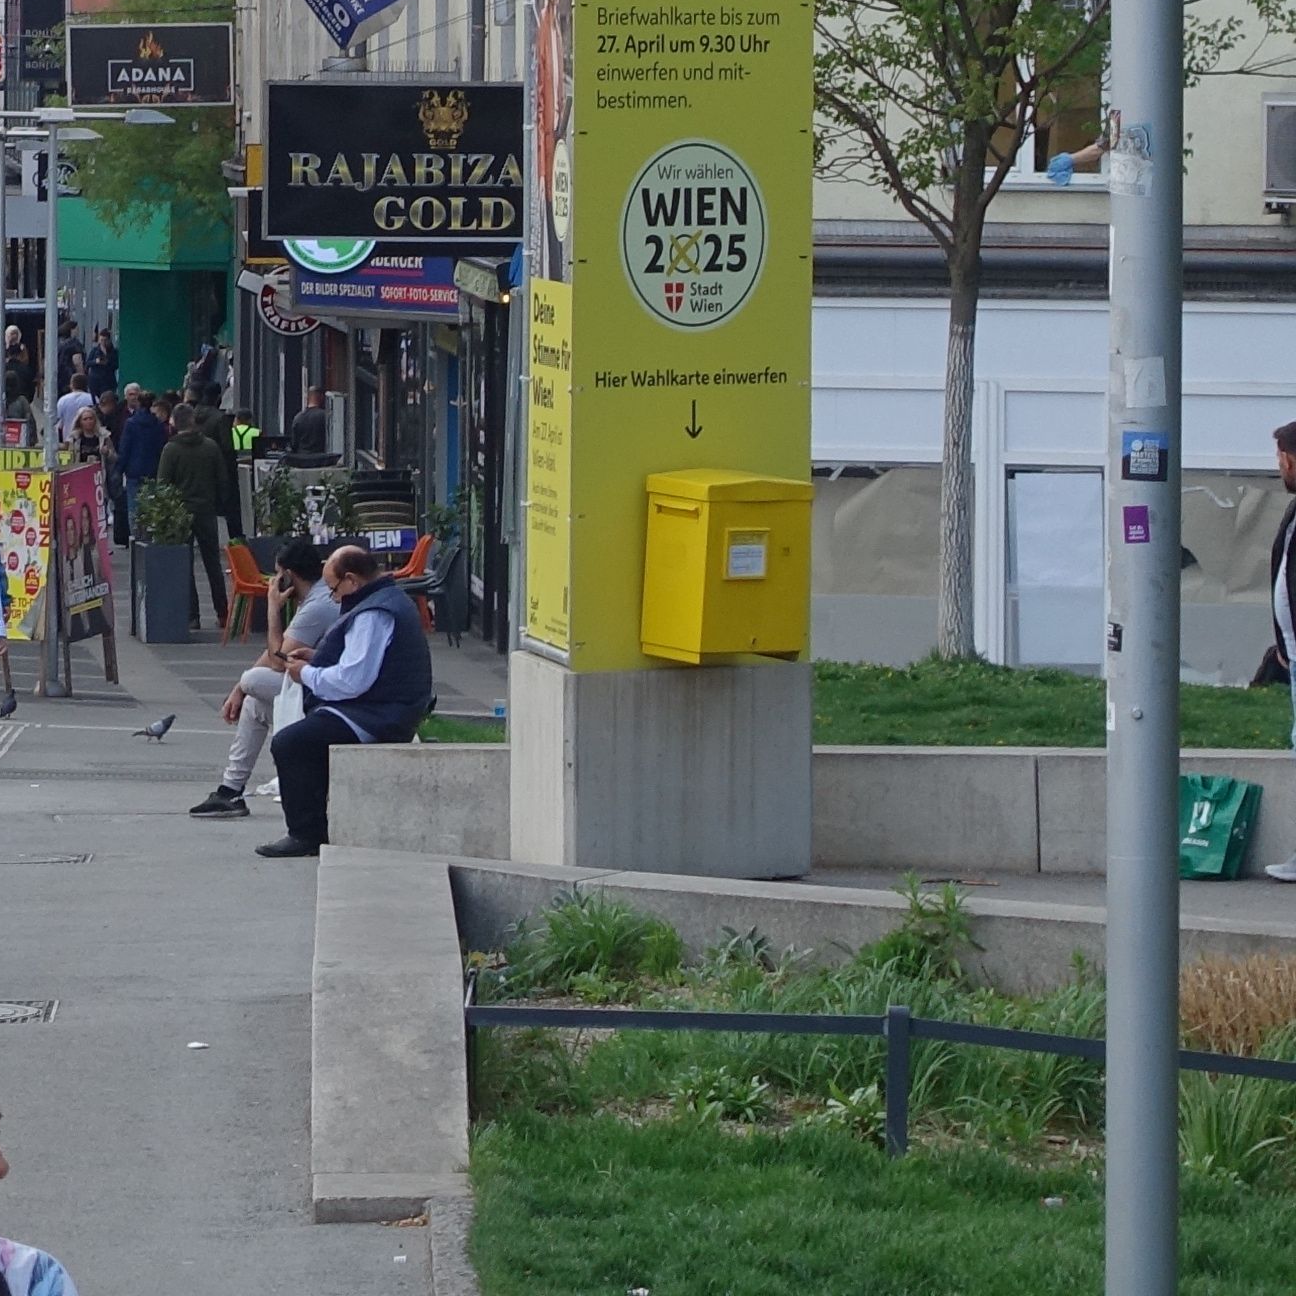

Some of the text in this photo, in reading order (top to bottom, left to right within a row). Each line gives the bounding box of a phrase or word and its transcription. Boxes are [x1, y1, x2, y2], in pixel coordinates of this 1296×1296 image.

[597, 6, 780, 26] Briefwahlkarte bis zum
[597, 34, 770, 59] 27. April um 9.30 Uhr
[116, 67, 186, 82] ADANA
[597, 62, 751, 81] einwerfen und mit-
[597, 90, 692, 109] bestimmen.
[429, 138, 458, 146] GOLD
[287, 152, 523, 192] RAJABIZA
[658, 164, 733, 180] Wir wählen
[373, 196, 516, 231] GOLD
[641, 187, 748, 227] WIEN
[301, 282, 458, 303] DER BILDER SPEZIALIST SOFORT-FOTO-SERVICE
[690, 281, 723, 296] Stadt
[261, 292, 310, 332] TRAFIK
[534, 292, 555, 326] Deine
[690, 298, 723, 312] Wien
[533, 333, 560, 370] Stimme
[595, 367, 787, 388] Hier Wahlkarte einwerfen
[532, 375, 554, 409] Wien!
[29, 451, 72, 468] MT
[39, 480, 51, 548] NEOS
[94, 471, 108, 540] NEOS
